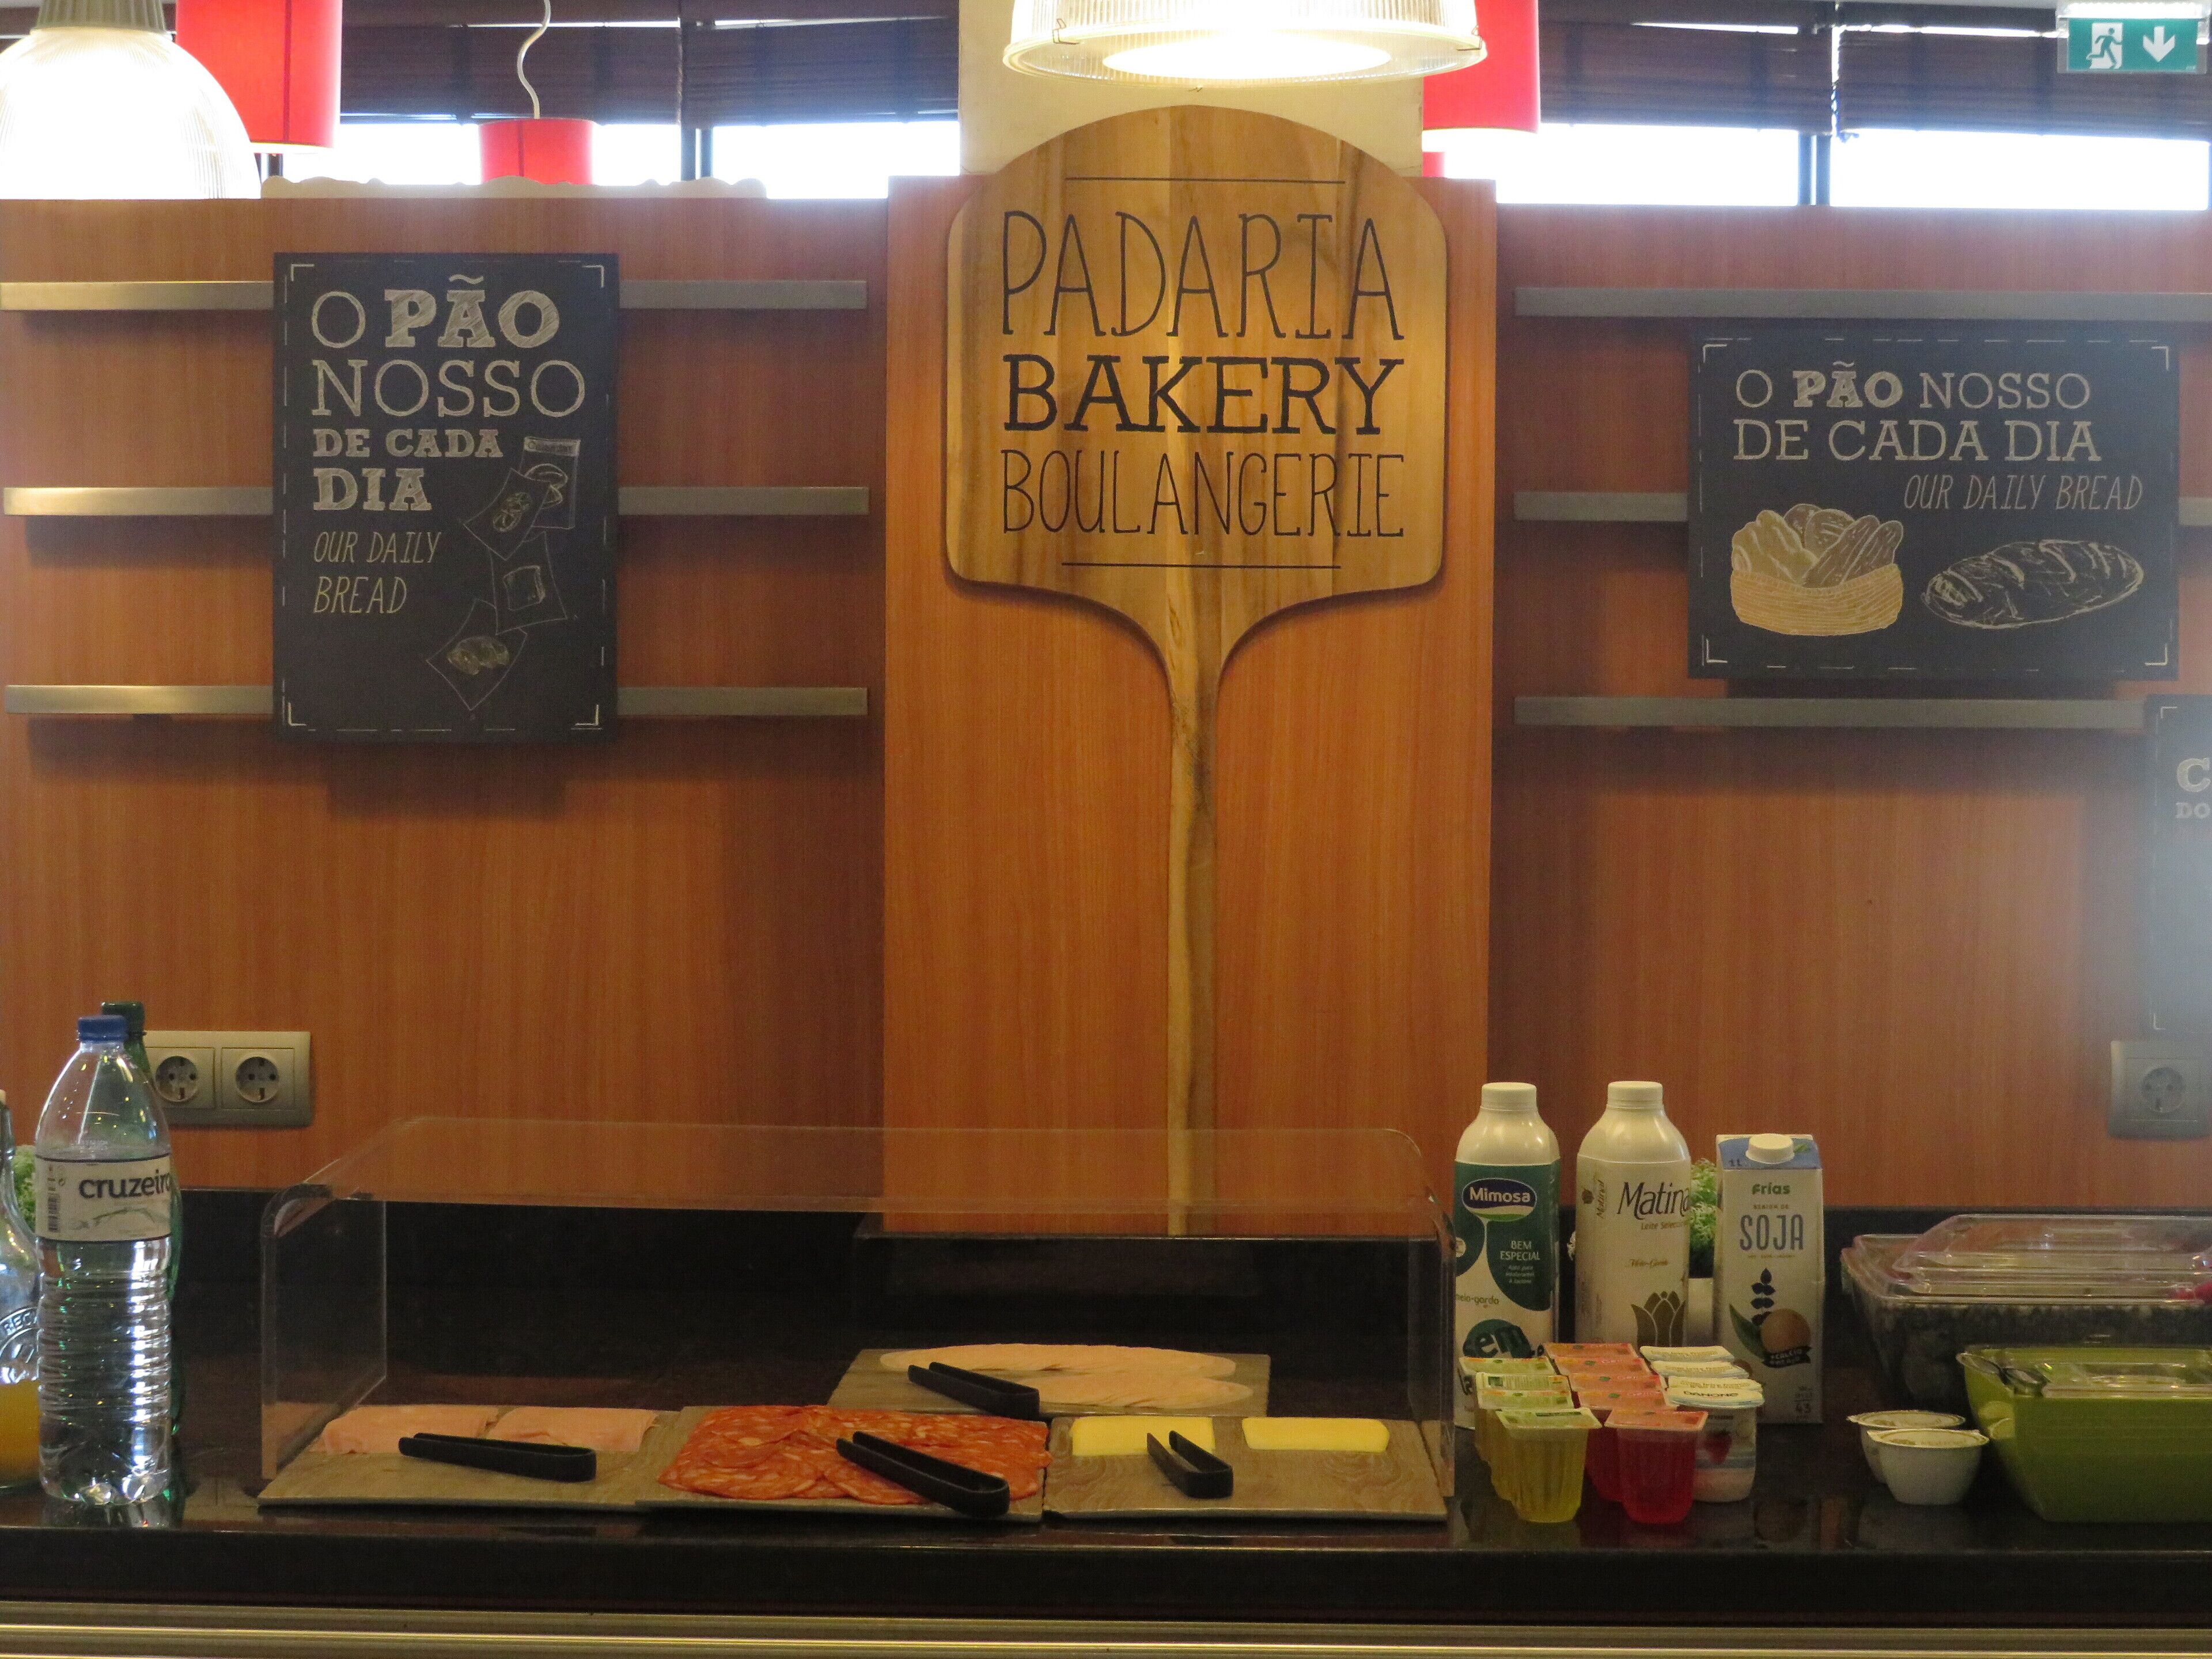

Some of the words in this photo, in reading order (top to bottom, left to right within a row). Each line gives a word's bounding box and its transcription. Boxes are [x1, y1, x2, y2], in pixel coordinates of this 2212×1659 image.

[1002, 210, 1404, 340] PADARIA
[312, 291, 366, 348] O
[384, 274, 559, 348] PÃO
[312, 359, 585, 416] NOSSO
[1003, 354, 1404, 435] BAKERY
[1736, 369, 1772, 408] O
[1793, 361, 1903, 409] PÃO
[1919, 372, 2090, 409] NOSSO
[313, 429, 370, 457] DE
[386, 428, 503, 458] CADA
[1733, 419, 1808, 461] DE
[1829, 420, 1988, 461] CADA
[2005, 420, 2102, 461] DIA
[313, 468, 431, 511] DIA
[1001, 449, 1403, 536] BOULANGERIE
[1904, 475, 1954, 509] OUR
[1963, 474, 2047, 510] DAILY
[2056, 475, 2143, 510] BREAD
[313, 531, 355, 562] OUR
[366, 531, 441, 563] DAILY
[313, 576, 406, 613] BREAD
[1469, 1187, 1531, 1203] Mimosa
[1752, 1182, 1791, 1195] Frías
[1511, 1240, 1532, 1250] BEM
[1740, 1214, 1804, 1251] SOJA
[1500, 1251, 1540, 1261] ESPECIAL
